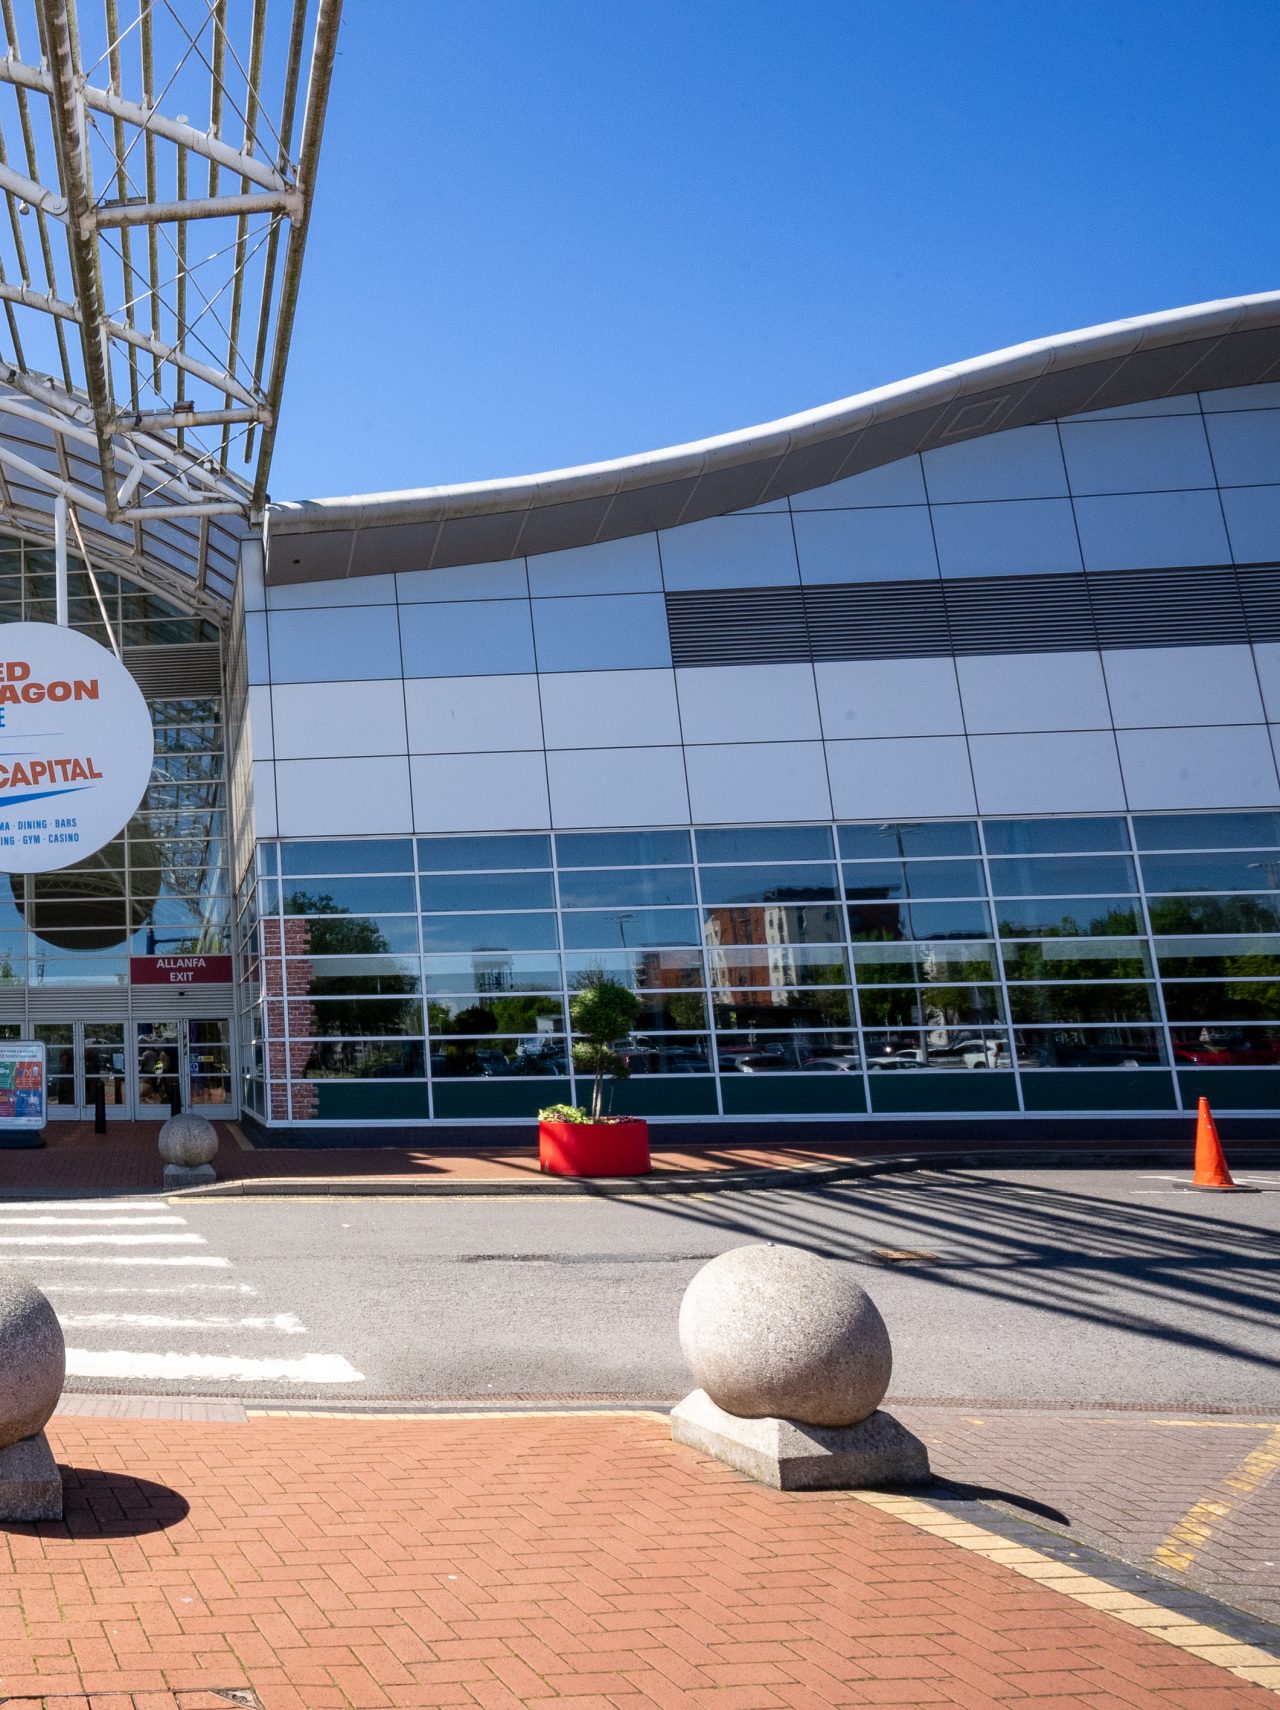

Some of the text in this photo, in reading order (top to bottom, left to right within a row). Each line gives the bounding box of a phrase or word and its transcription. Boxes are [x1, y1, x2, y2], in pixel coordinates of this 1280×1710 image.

[18, 820, 48, 830] DINING
[55, 818, 77, 828] BARS
[22, 834, 41, 844] GYM
[48, 833, 79, 843] CASINO
[156, 958, 206, 968] ALLANFA
[170, 972, 194, 982] EXIT
